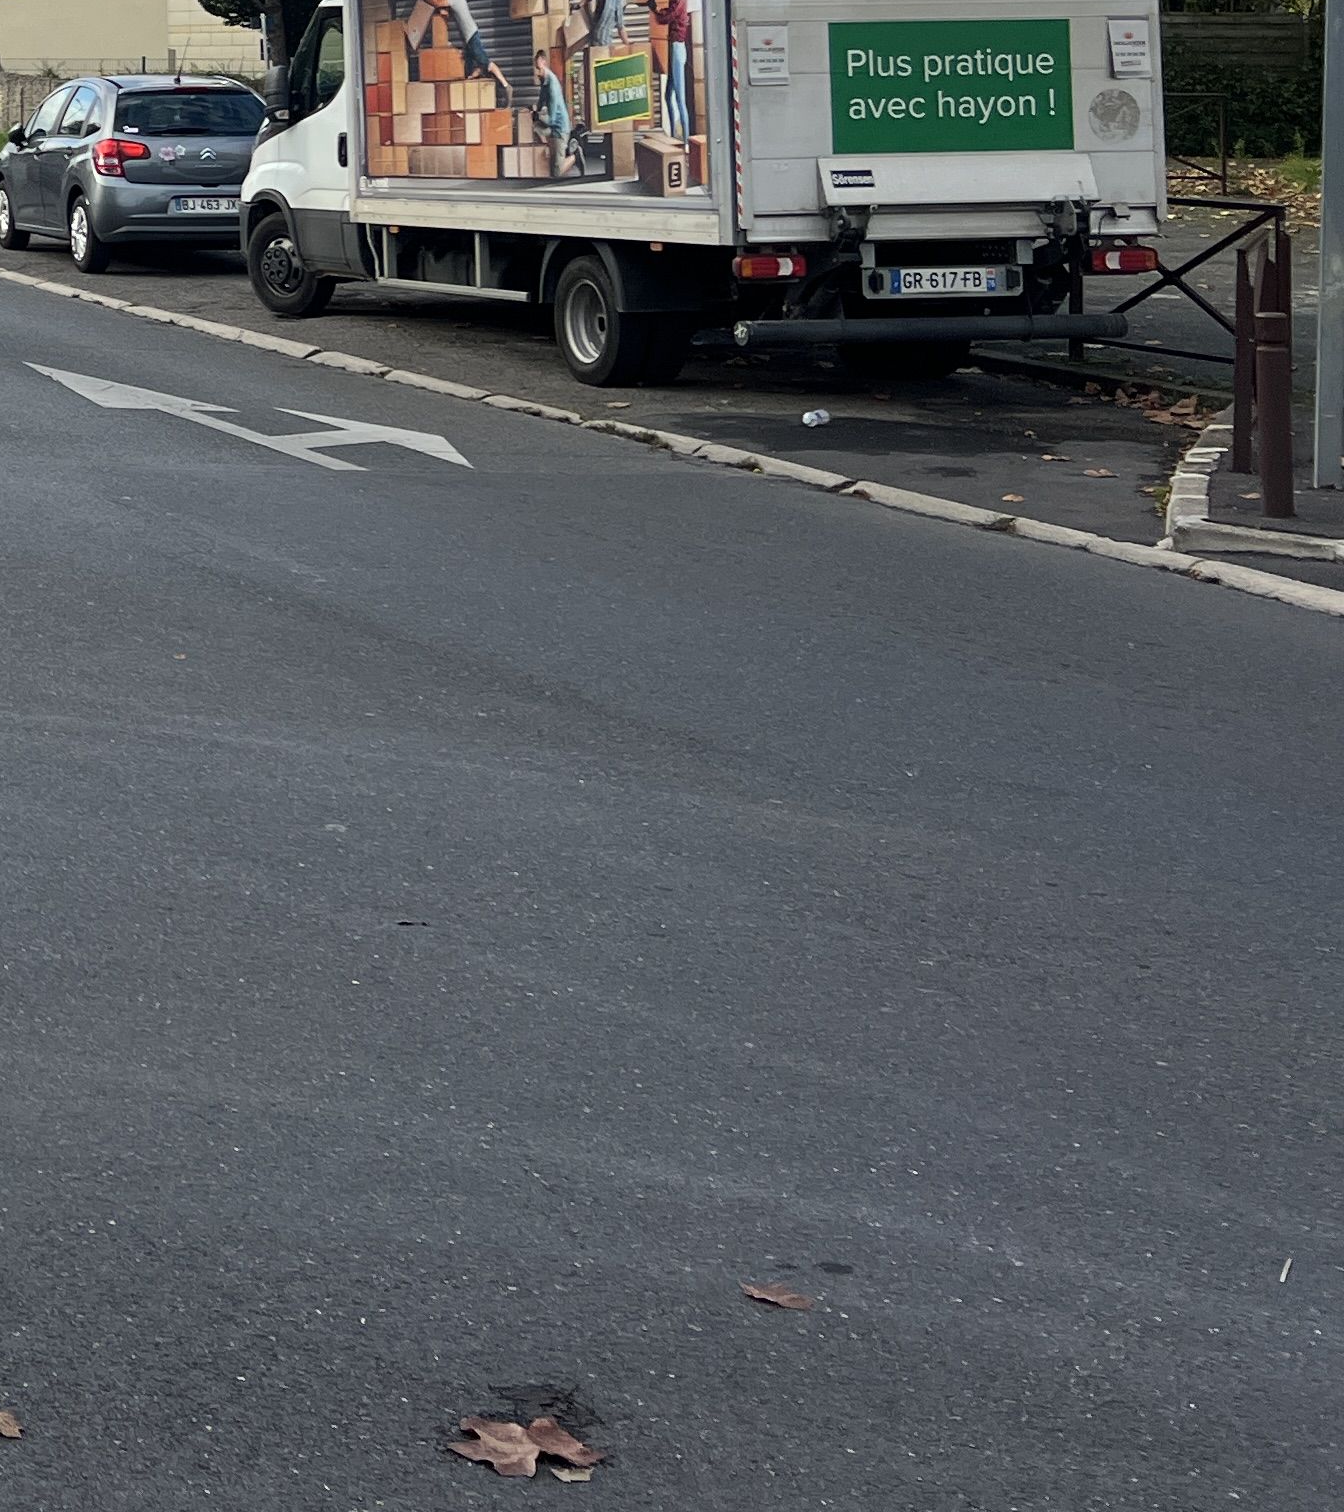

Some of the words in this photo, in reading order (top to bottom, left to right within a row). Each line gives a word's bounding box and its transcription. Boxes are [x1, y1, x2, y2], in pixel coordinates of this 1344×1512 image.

[846, 49, 912, 77] Plus
[923, 48, 1055, 83] pratique
[848, 96, 926, 120] avec
[937, 90, 1037, 124] hayon
[1048, 88, 1057, 116] !
[902, 271, 982, 289] GR-617-FB
